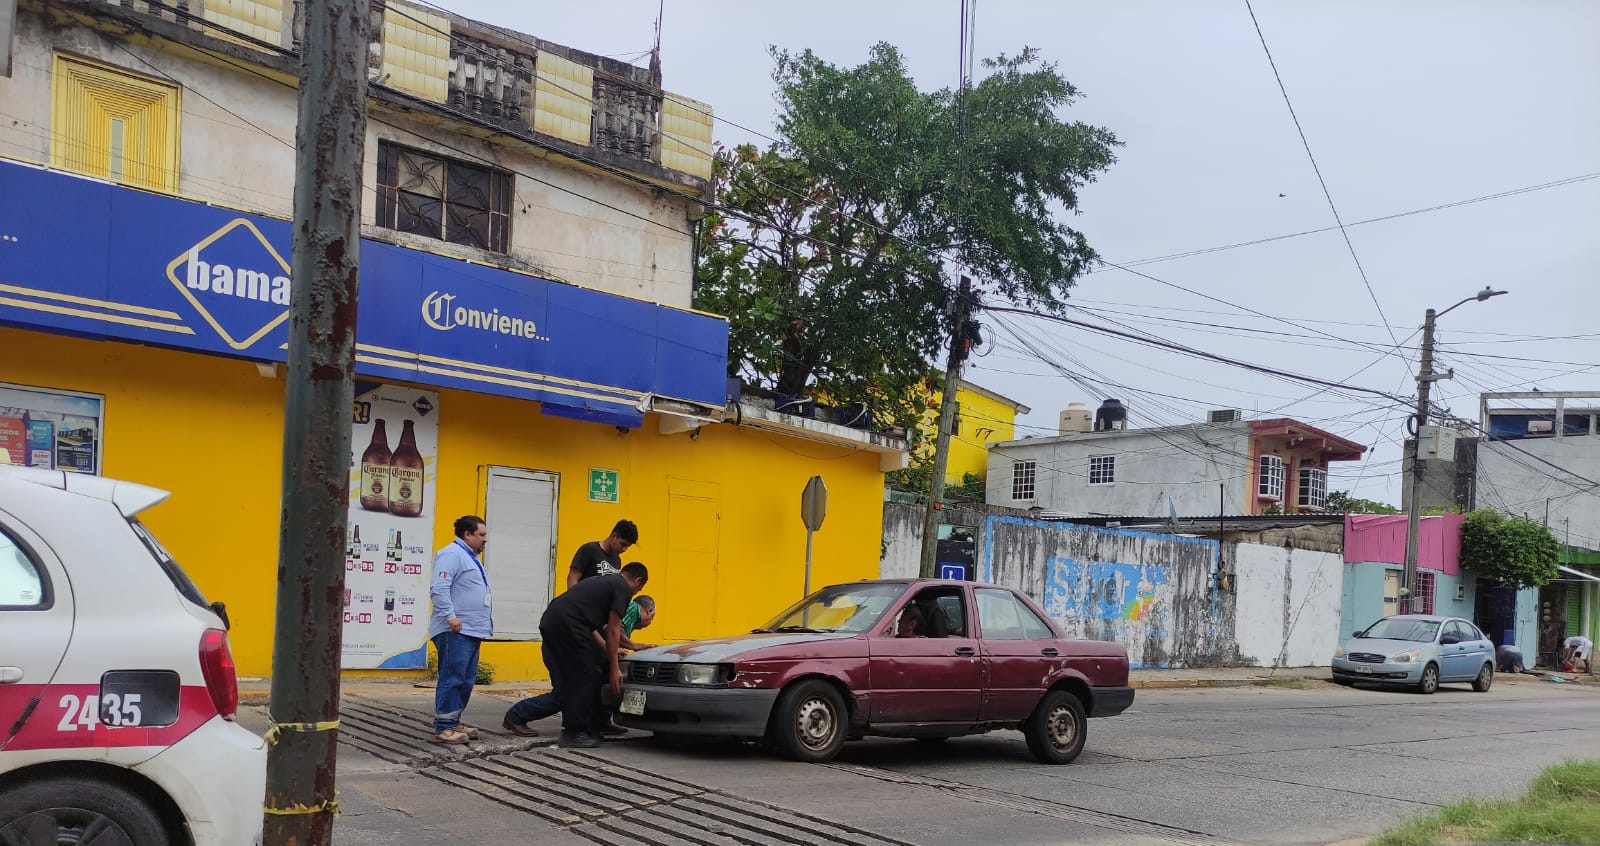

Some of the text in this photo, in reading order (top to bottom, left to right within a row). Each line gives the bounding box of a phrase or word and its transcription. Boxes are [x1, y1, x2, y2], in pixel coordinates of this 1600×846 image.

[187, 244, 291, 305] bama
[421, 290, 550, 341] Conviene...
[57, 693, 141, 732] 2435
